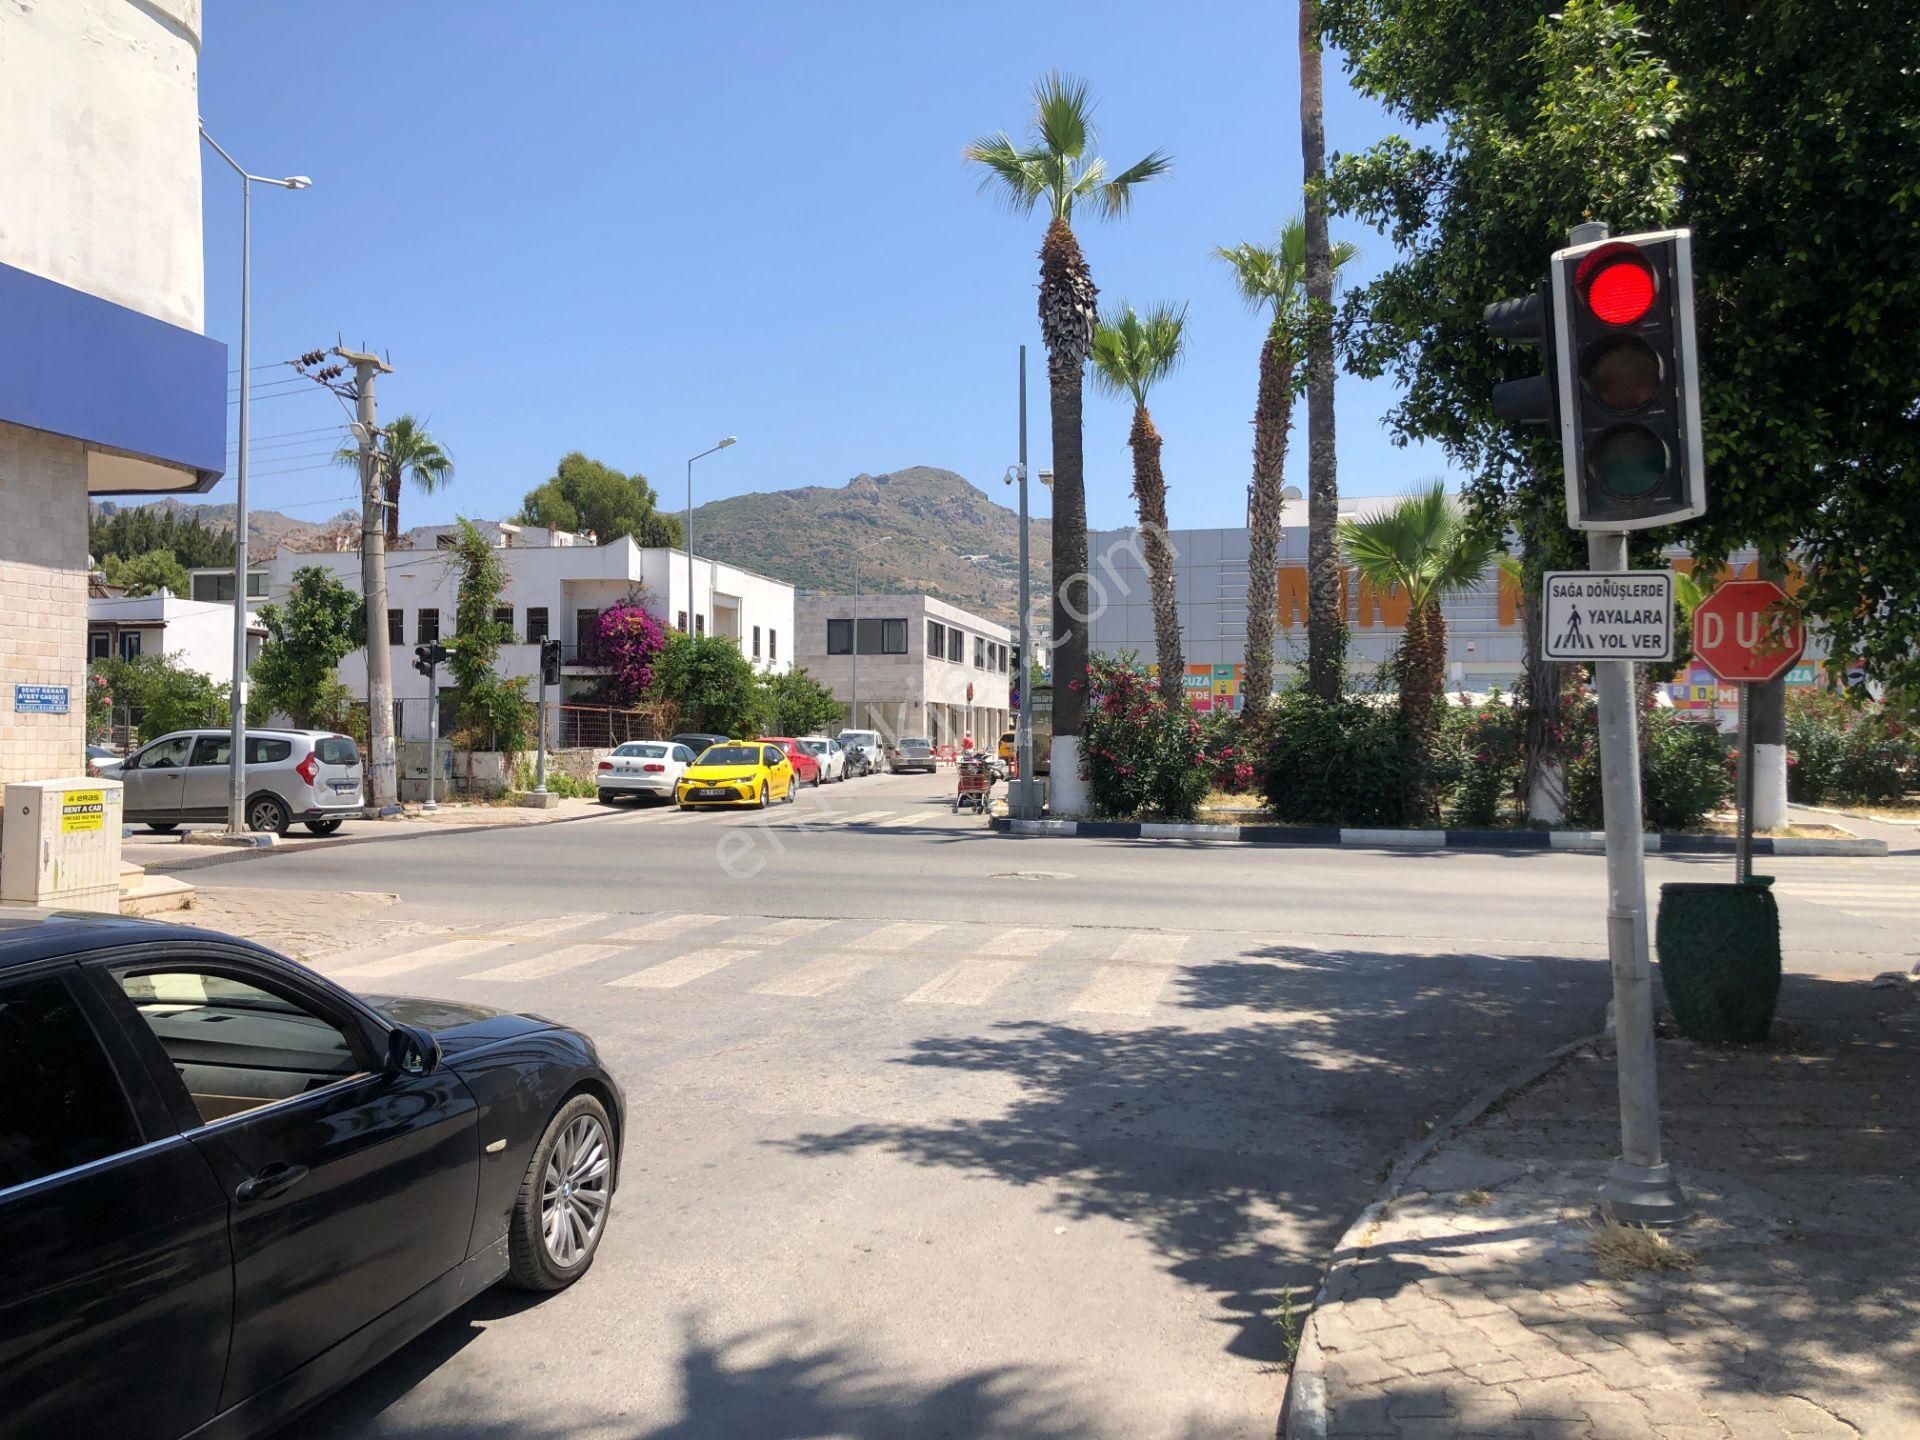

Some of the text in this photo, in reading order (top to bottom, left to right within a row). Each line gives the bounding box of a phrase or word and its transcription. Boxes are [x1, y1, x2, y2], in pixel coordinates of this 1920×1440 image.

[1553, 582, 1664, 601] SAĞA DÖNÜŞLERDE
[1588, 609, 1663, 624] YAYALARA
[1599, 634, 1662, 648] YOL VER
[63, 805, 81, 813] RENT
[88, 804, 102, 812] CAR
